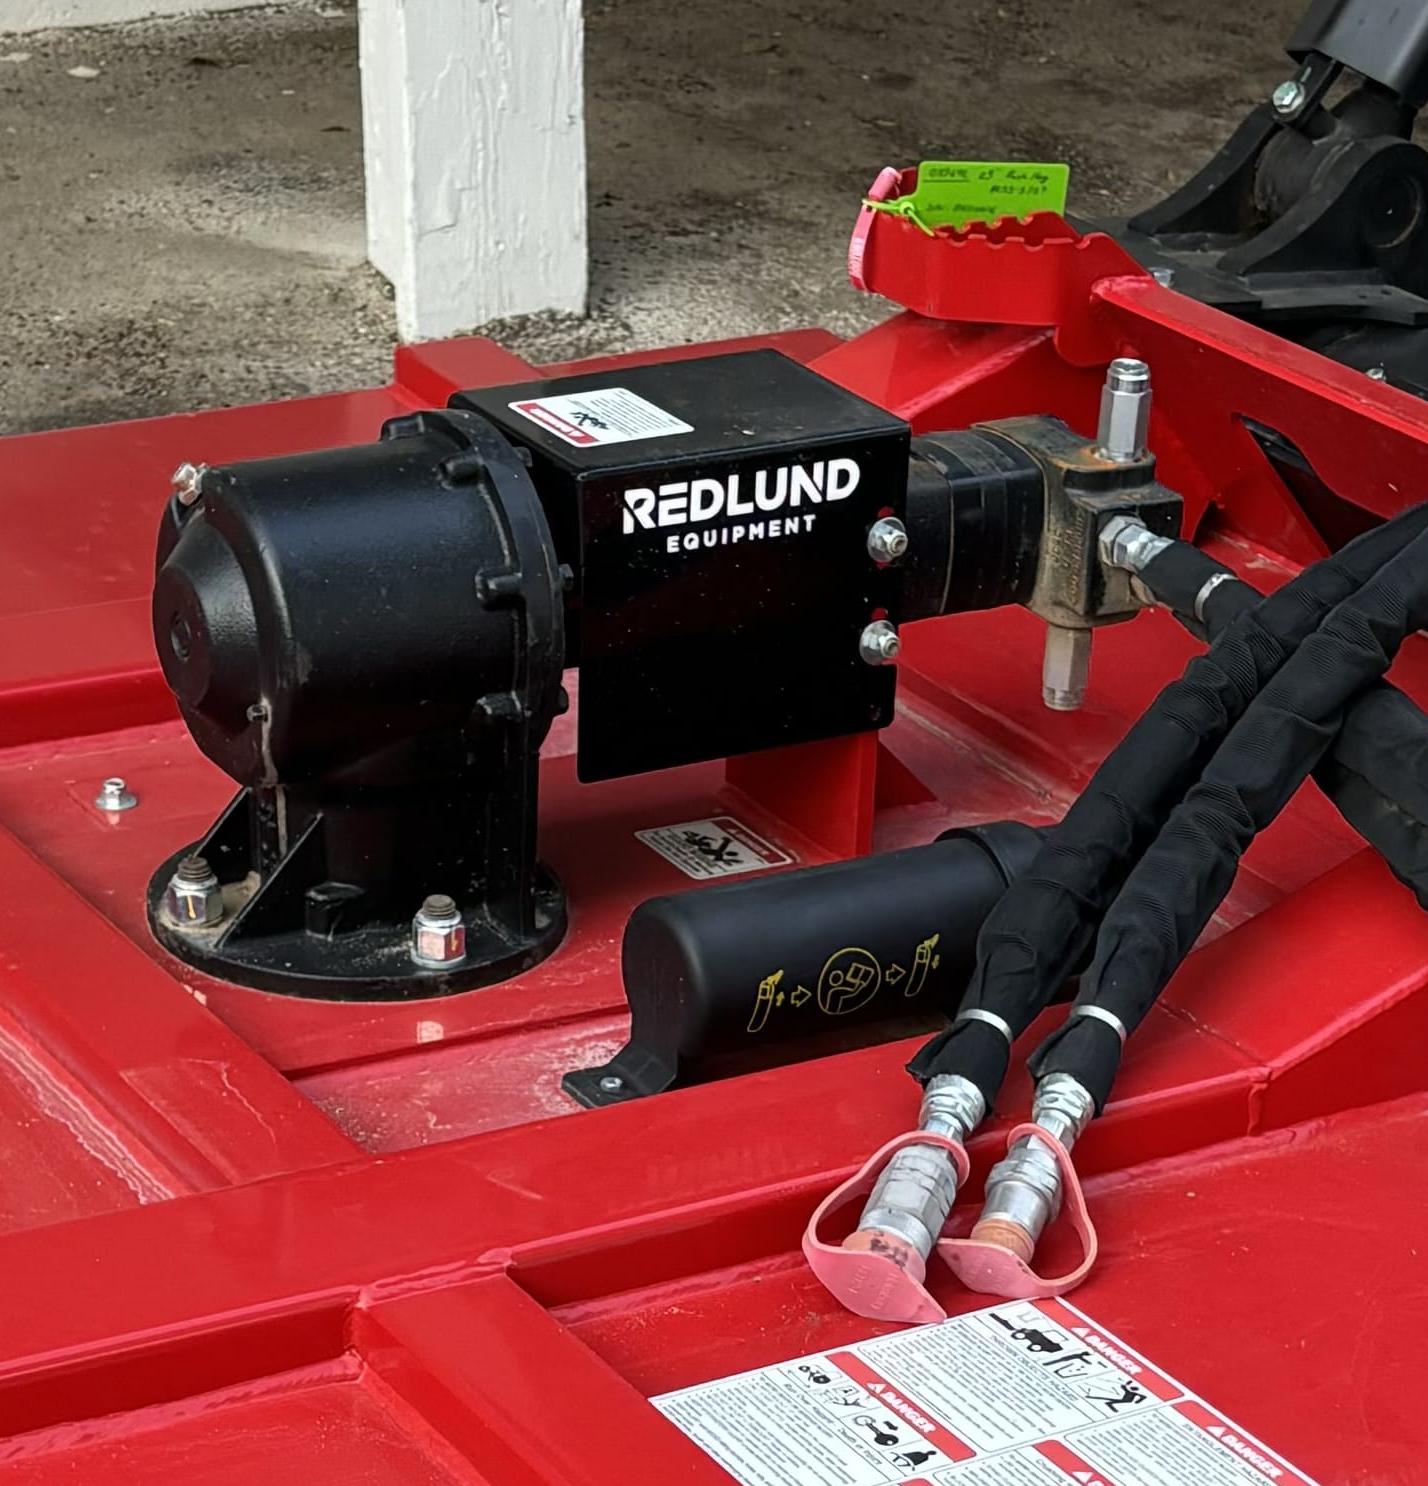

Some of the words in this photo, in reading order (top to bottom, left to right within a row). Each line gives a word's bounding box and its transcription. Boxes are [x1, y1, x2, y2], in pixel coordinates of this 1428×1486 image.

[622, 457, 861, 535] REDLUND
[665, 513, 819, 555] EQUIPMENT
[1082, 1334, 1145, 1375] DANGER
[877, 1390, 939, 1433] DANGER
[1218, 1433, 1286, 1478] DANGER
